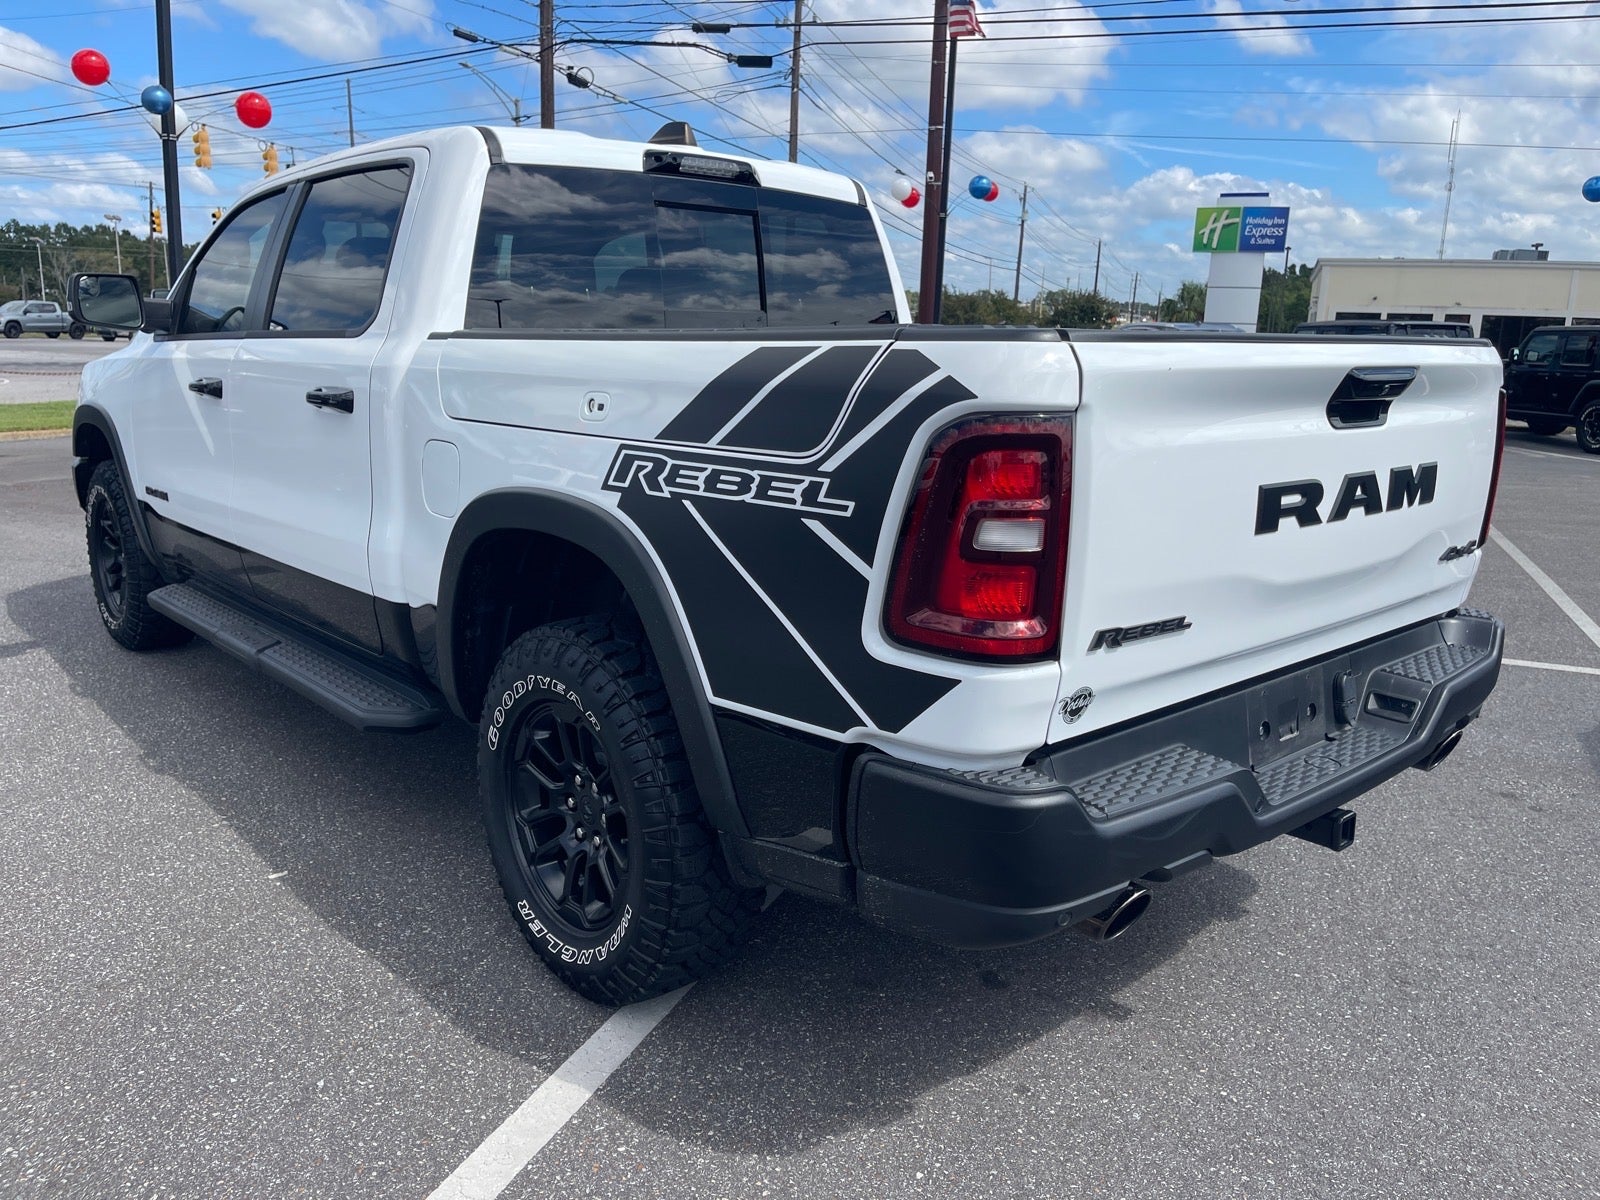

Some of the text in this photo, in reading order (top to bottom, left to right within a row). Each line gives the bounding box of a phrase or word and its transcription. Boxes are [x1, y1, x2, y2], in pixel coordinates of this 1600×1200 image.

[1244, 225, 1284, 237] Express
[1246, 216, 1285, 226] Holiday Inn
[607, 449, 856, 518] REBEL
[1254, 460, 1438, 536] RAM
[1086, 615, 1193, 653] REBEL
[487, 674, 601, 751] GOODYEAR
[517, 899, 632, 965] WRANGLER
